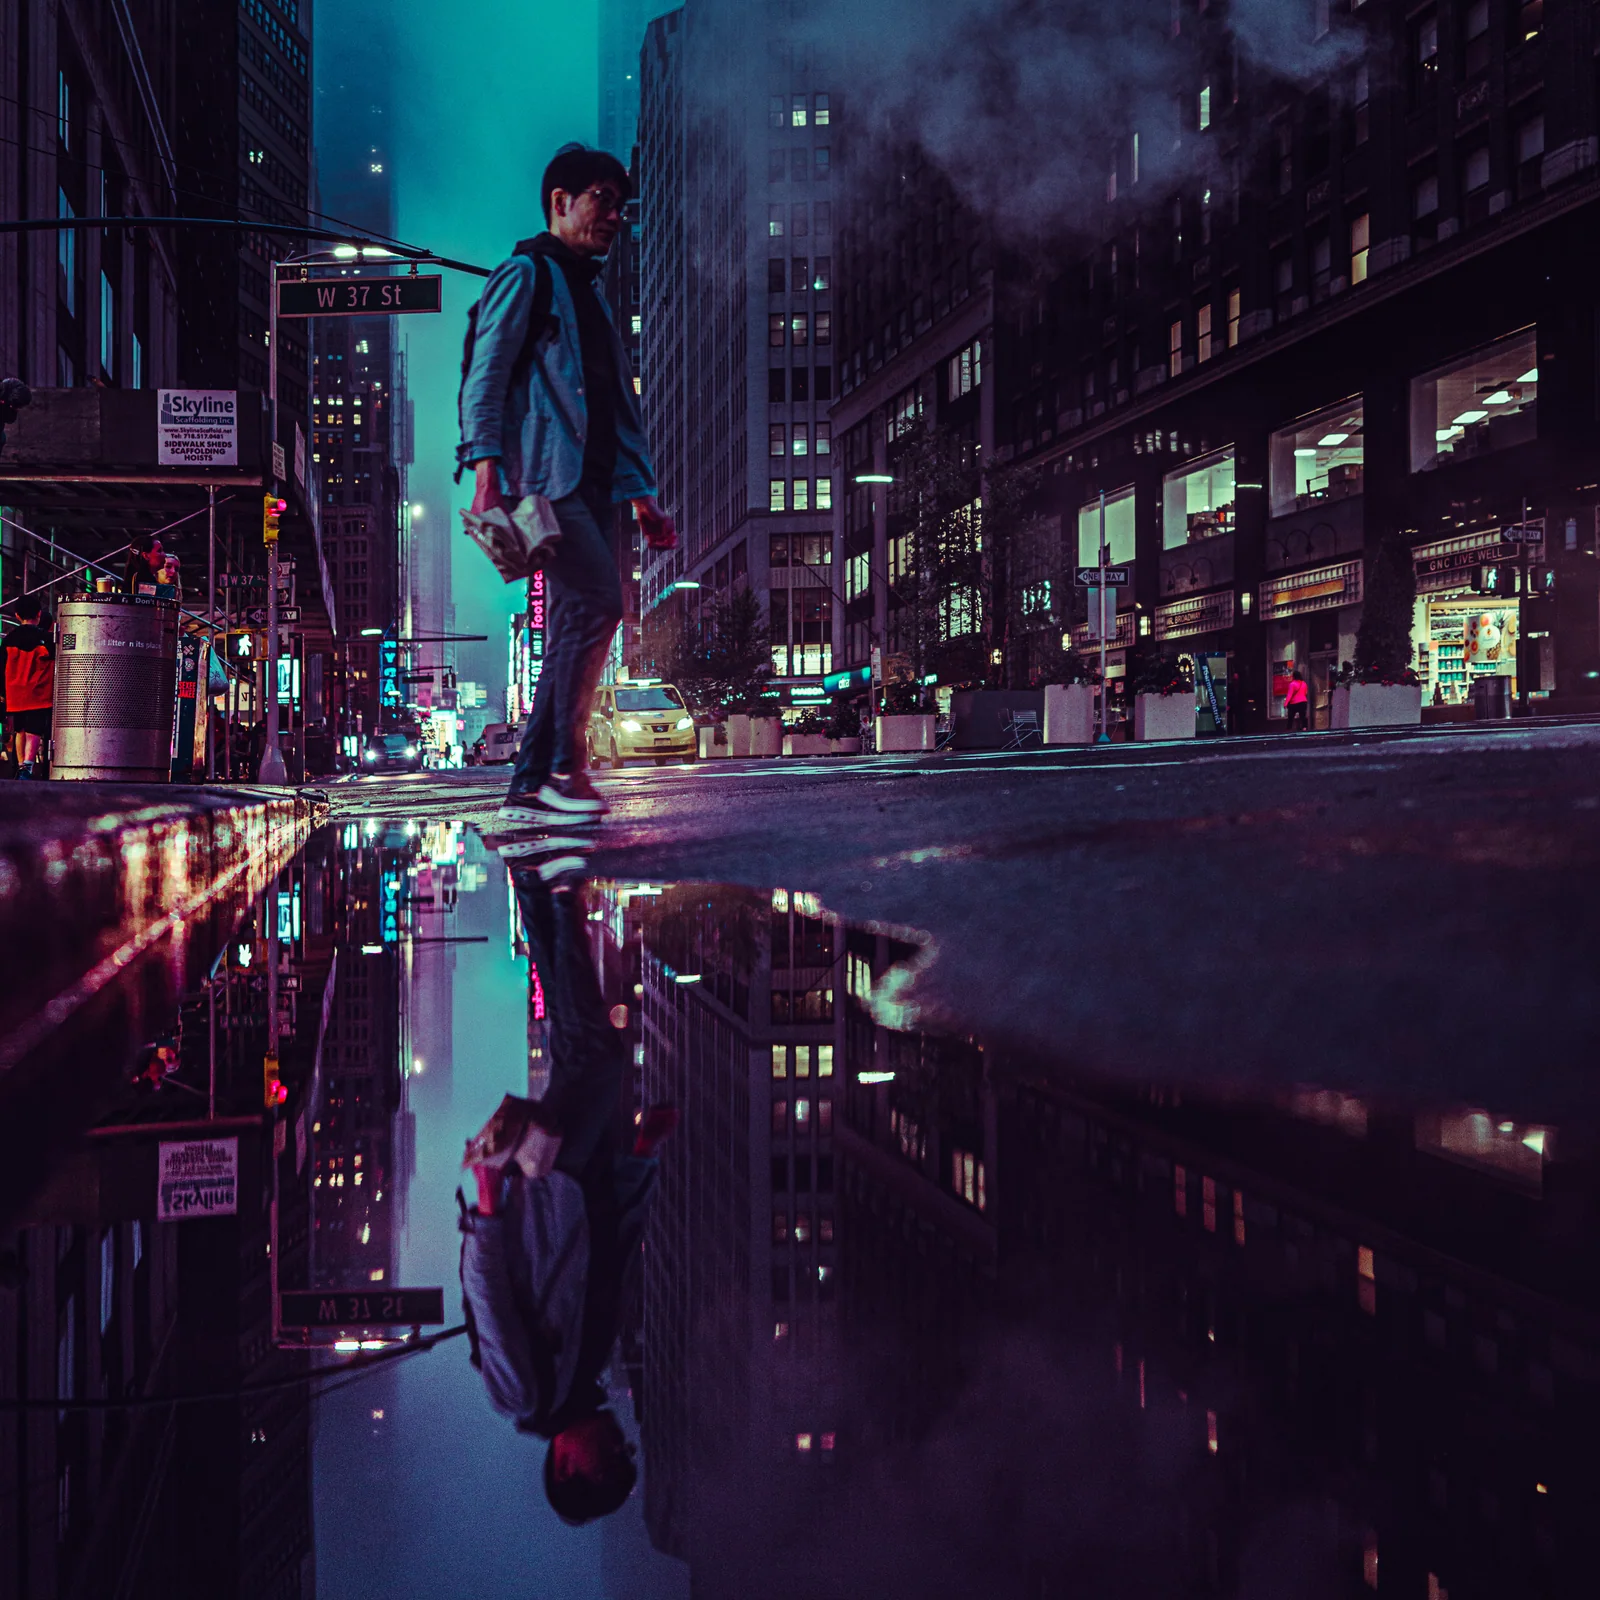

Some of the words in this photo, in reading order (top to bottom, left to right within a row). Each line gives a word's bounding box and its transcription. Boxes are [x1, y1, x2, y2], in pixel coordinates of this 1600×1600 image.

[317, 287, 336, 308] W
[347, 286, 370, 307] 37
[381, 284, 402, 306] St
[172, 396, 234, 417] Skyline
[175, 416, 218, 424] Scaffolding
[1507, 529, 1520, 538] ONE
[1429, 559, 1450, 571] GNC
[1454, 554, 1474, 566] LIVE
[1477, 547, 1503, 561] WELL
[230, 575, 238, 585] W
[241, 575, 254, 585] 37
[1082, 572, 1098, 580] ONE
[1105, 572, 1122, 580] WAY
[530, 599, 544, 629] Foot
